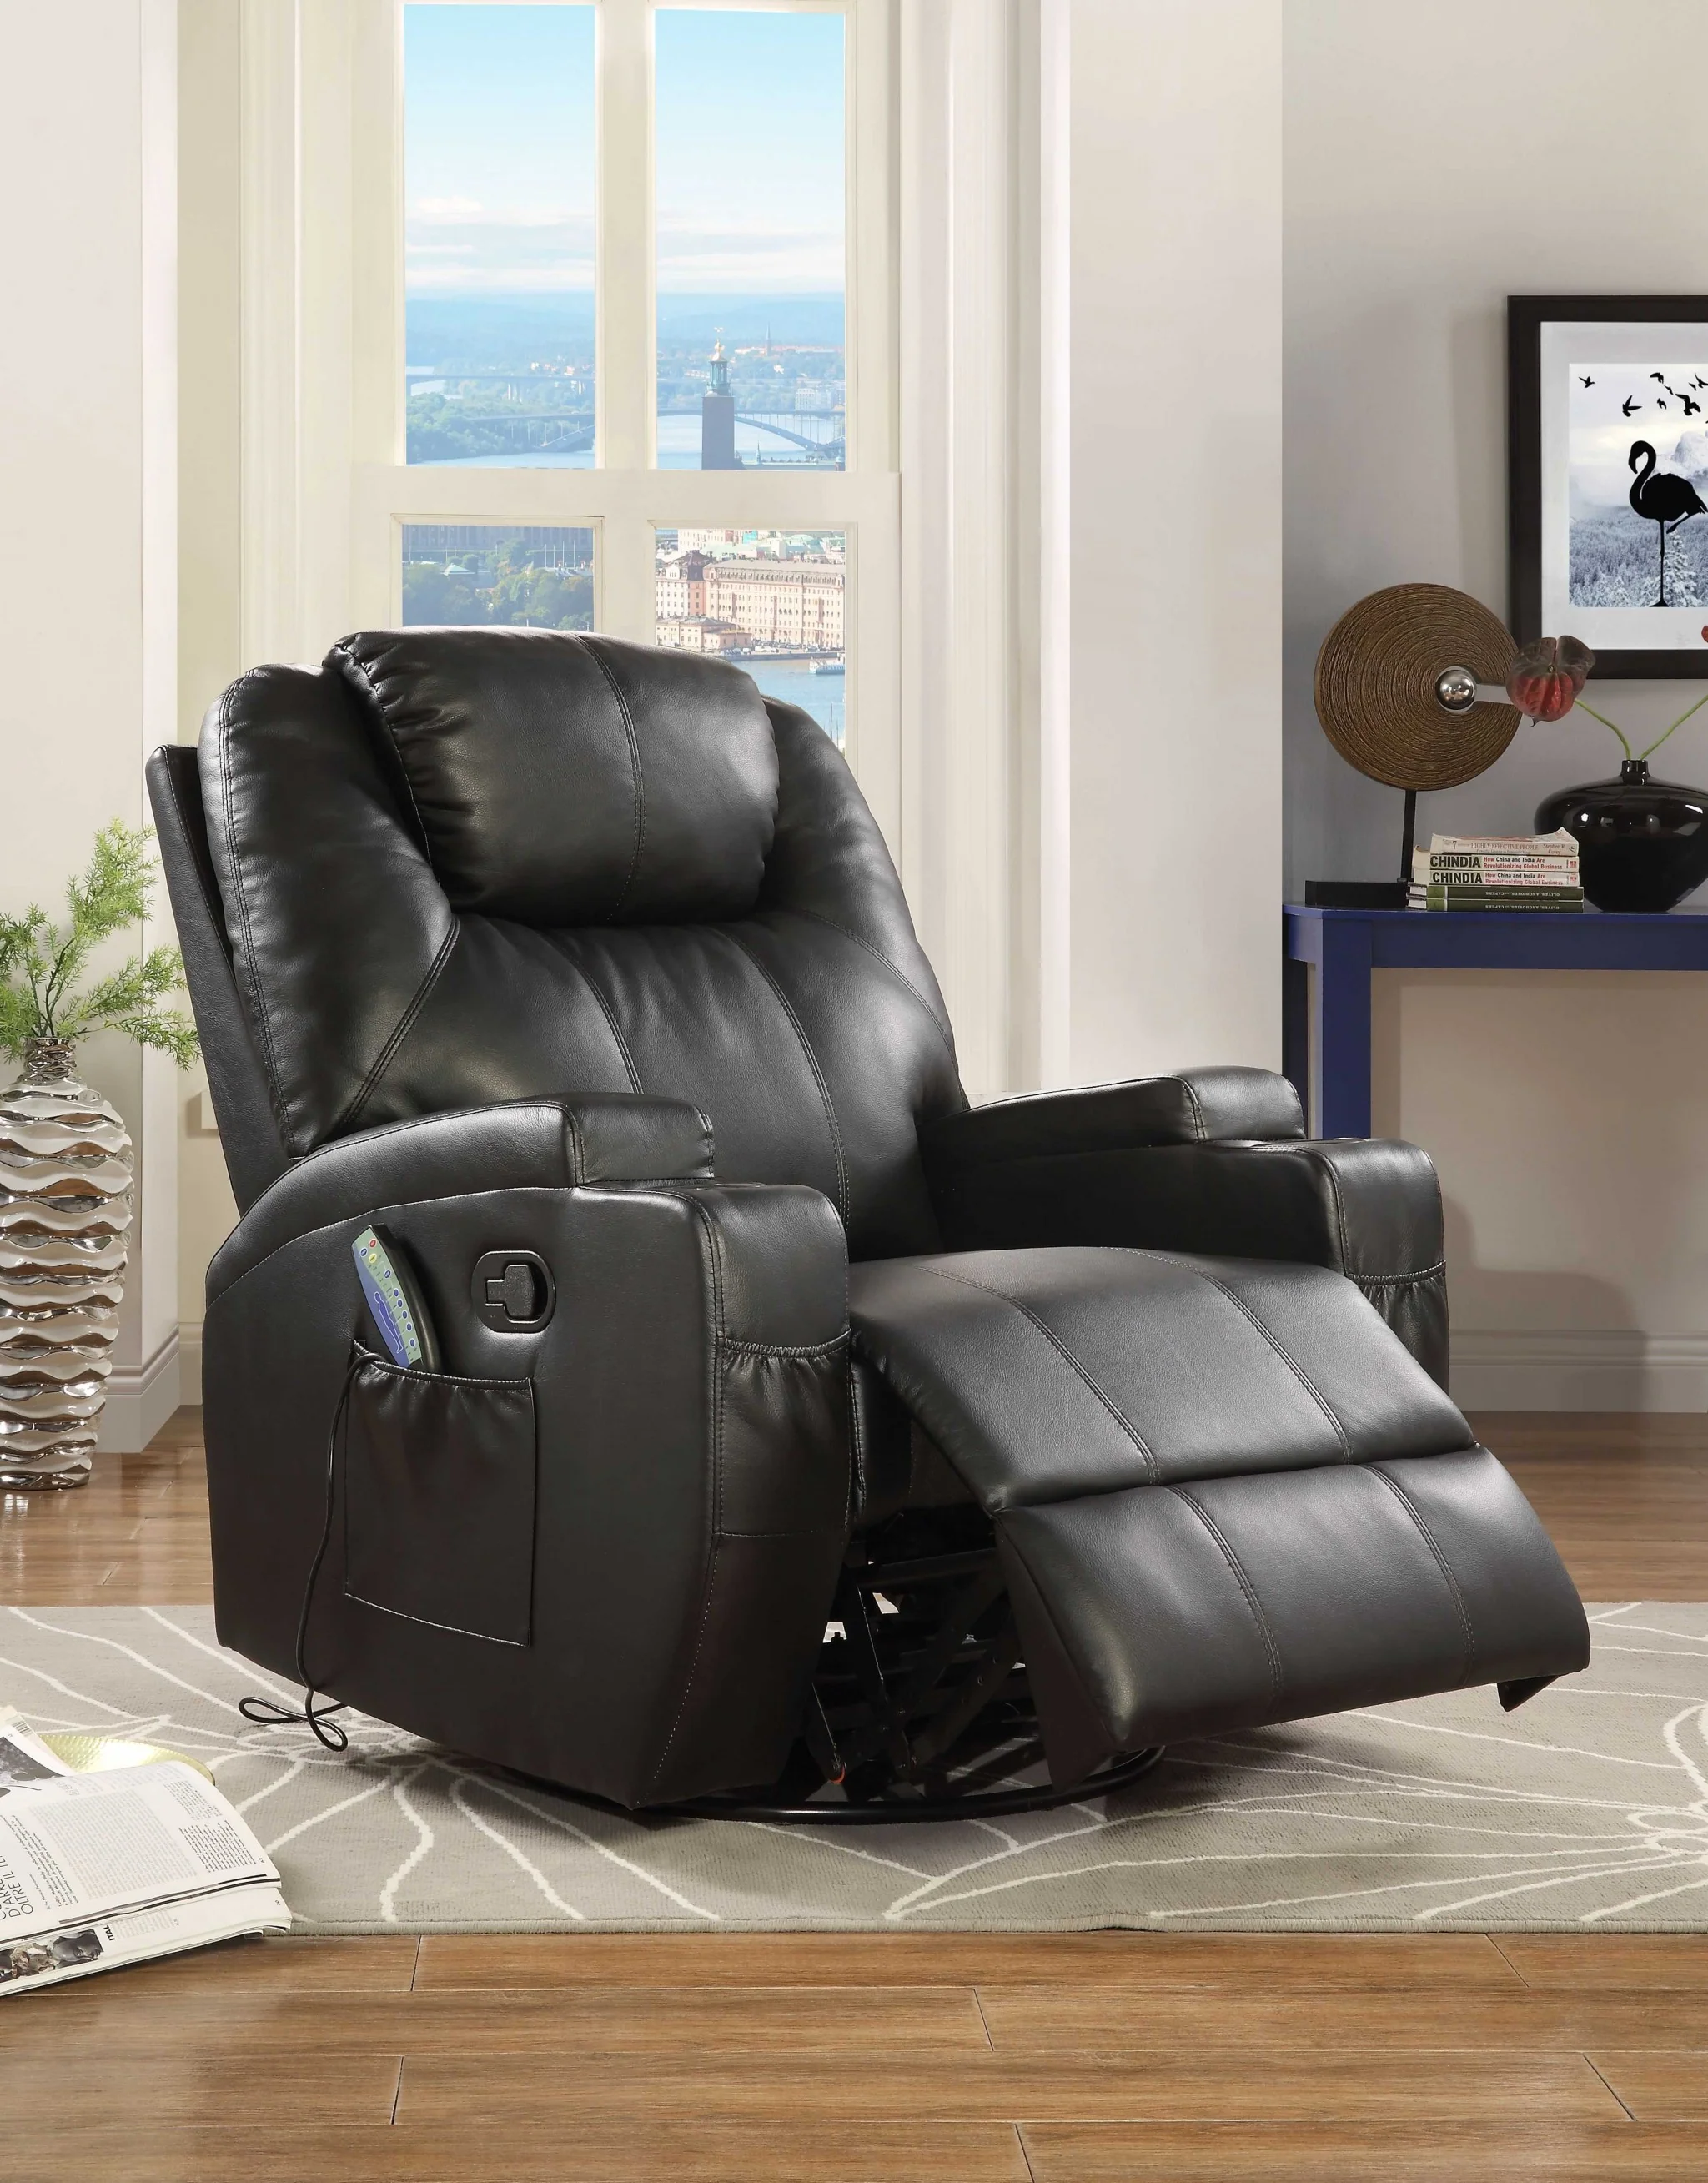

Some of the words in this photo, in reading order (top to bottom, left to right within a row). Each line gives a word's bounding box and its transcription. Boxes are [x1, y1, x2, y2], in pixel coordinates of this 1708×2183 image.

[1452, 841, 1457, 849] 7
[1430, 856, 1481, 868] CHINDIA
[1433, 872, 1483, 883] CHINDIA
[3, 1870, 15, 1879] IL
[8, 1882, 33, 1914] OLTRE
[103, 1925, 115, 1940] ITAL
